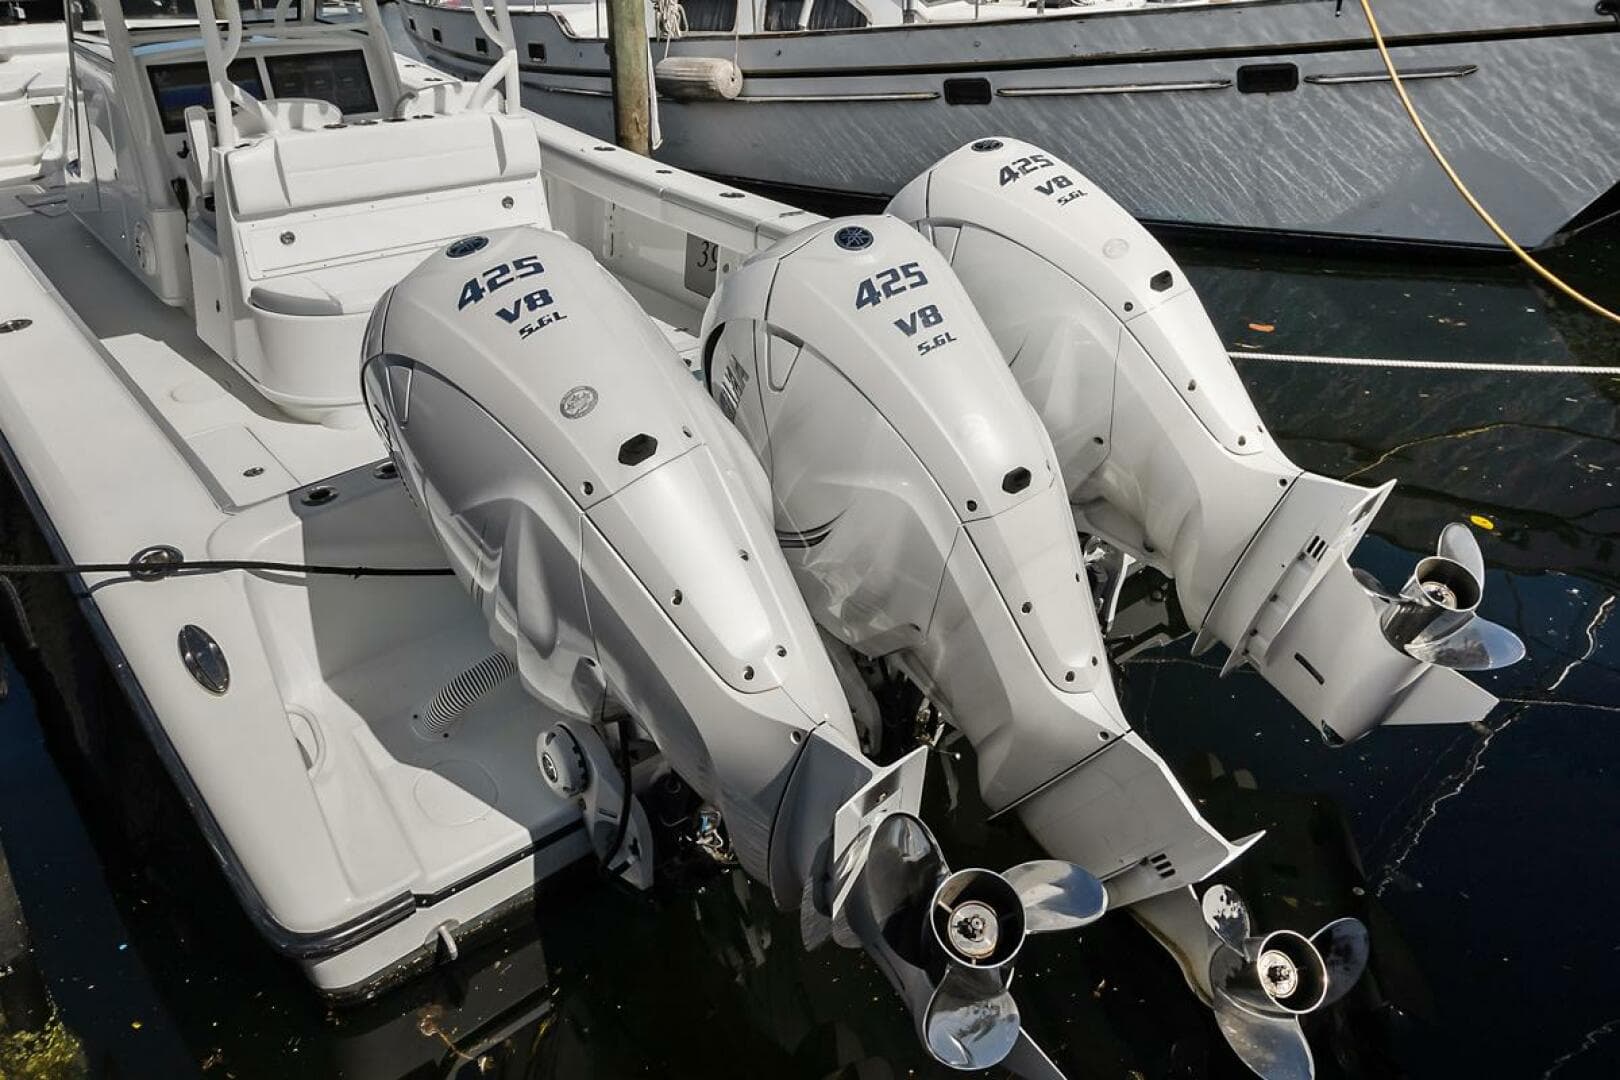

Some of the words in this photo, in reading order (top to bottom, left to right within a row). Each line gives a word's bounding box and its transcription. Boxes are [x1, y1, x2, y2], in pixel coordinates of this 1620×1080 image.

[999, 154, 1054, 186] 425
[1034, 175, 1073, 196] V8
[1057, 189, 1088, 206] 5.6L
[458, 255, 545, 311] 425
[855, 262, 928, 310] 425
[495, 288, 554, 324] V8
[893, 304, 943, 337] V8
[518, 311, 568, 340] 5.6L
[917, 332, 957, 356] 5.6L
